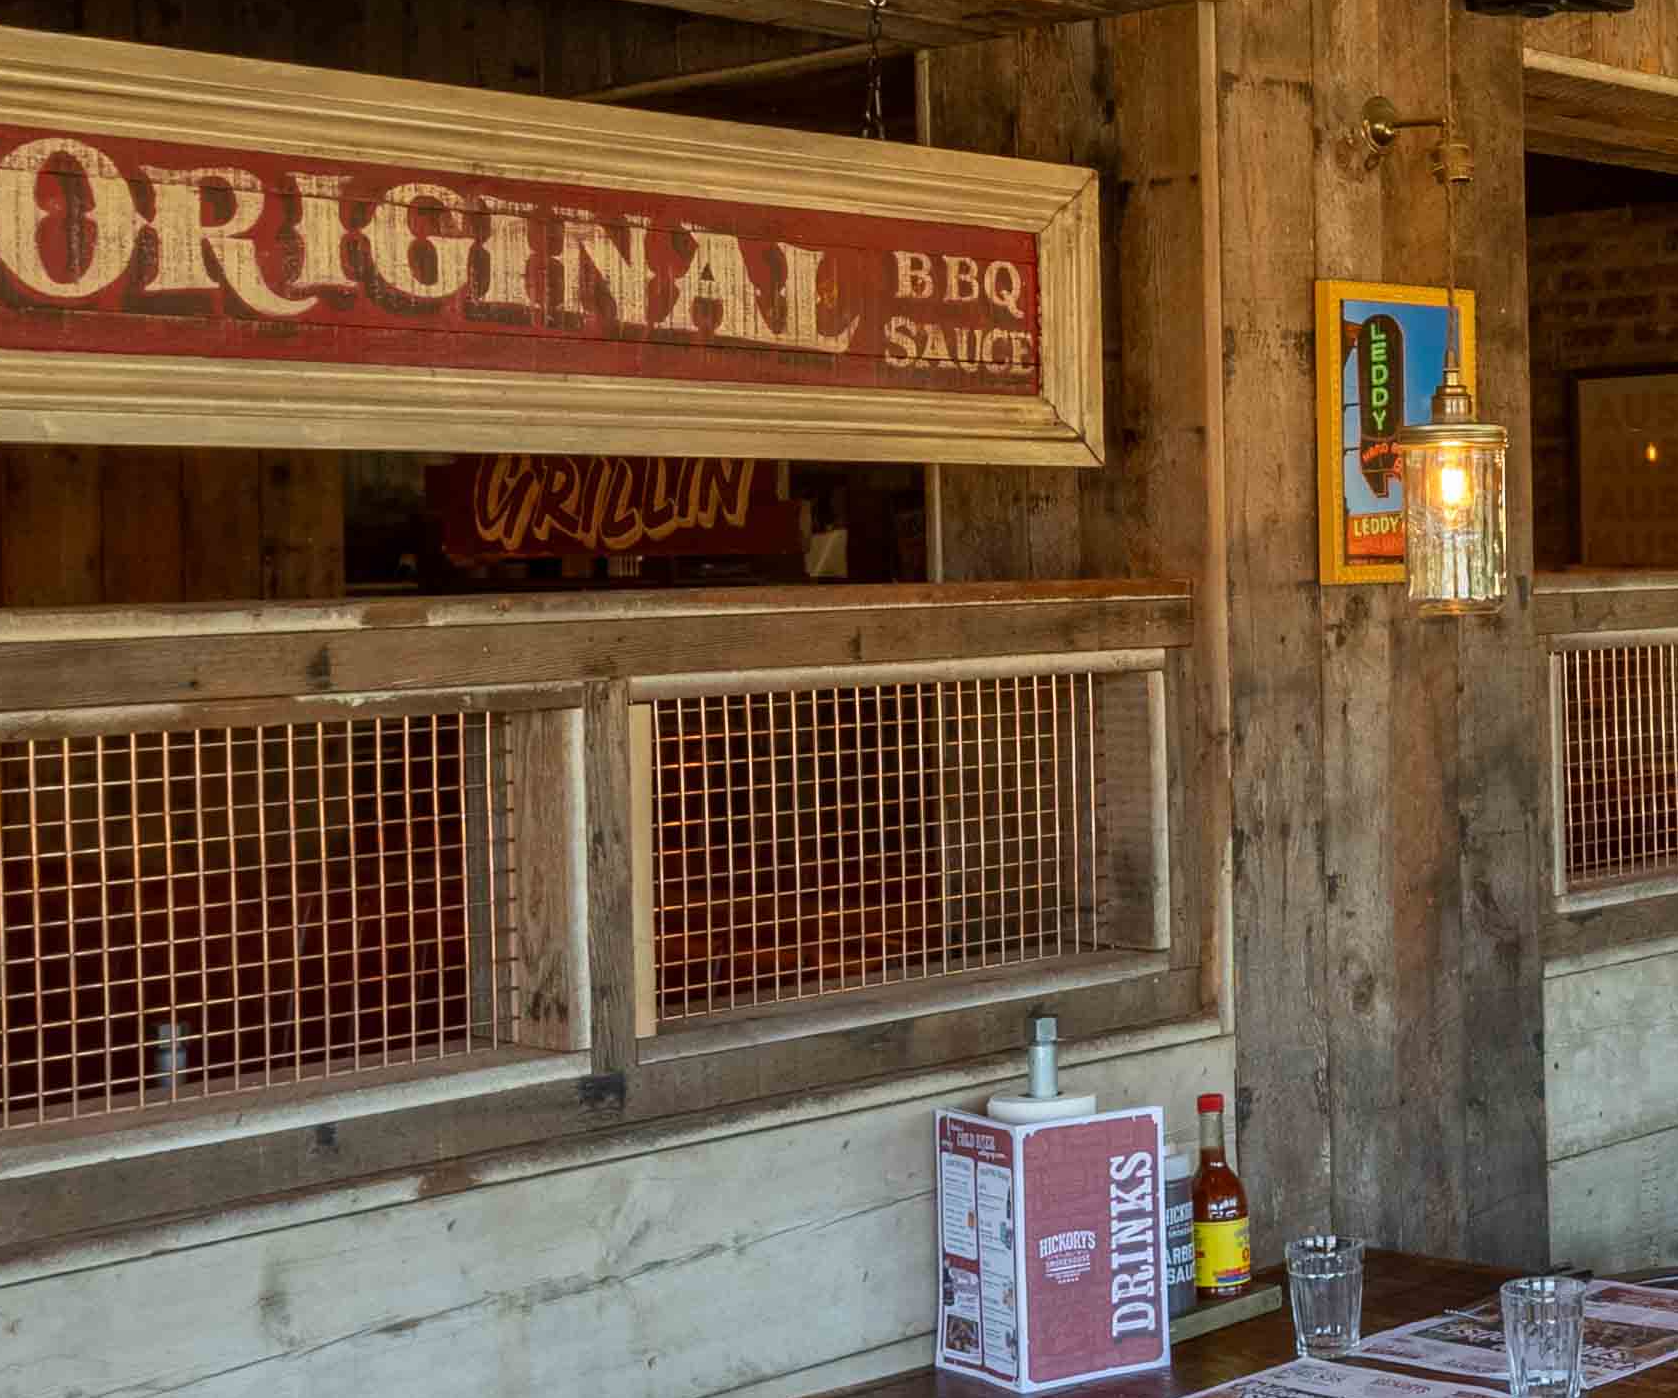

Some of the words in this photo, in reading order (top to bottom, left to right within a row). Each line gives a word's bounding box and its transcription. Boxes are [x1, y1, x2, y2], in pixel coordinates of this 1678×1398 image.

[893, 250, 1022, 318] BBQ
[883, 320, 1034, 374] SAUCE
[1370, 323, 1390, 431] LEDDY
[1353, 514, 1403, 538] LEDDY'
[1109, 1151, 1155, 1339] DRINKS
